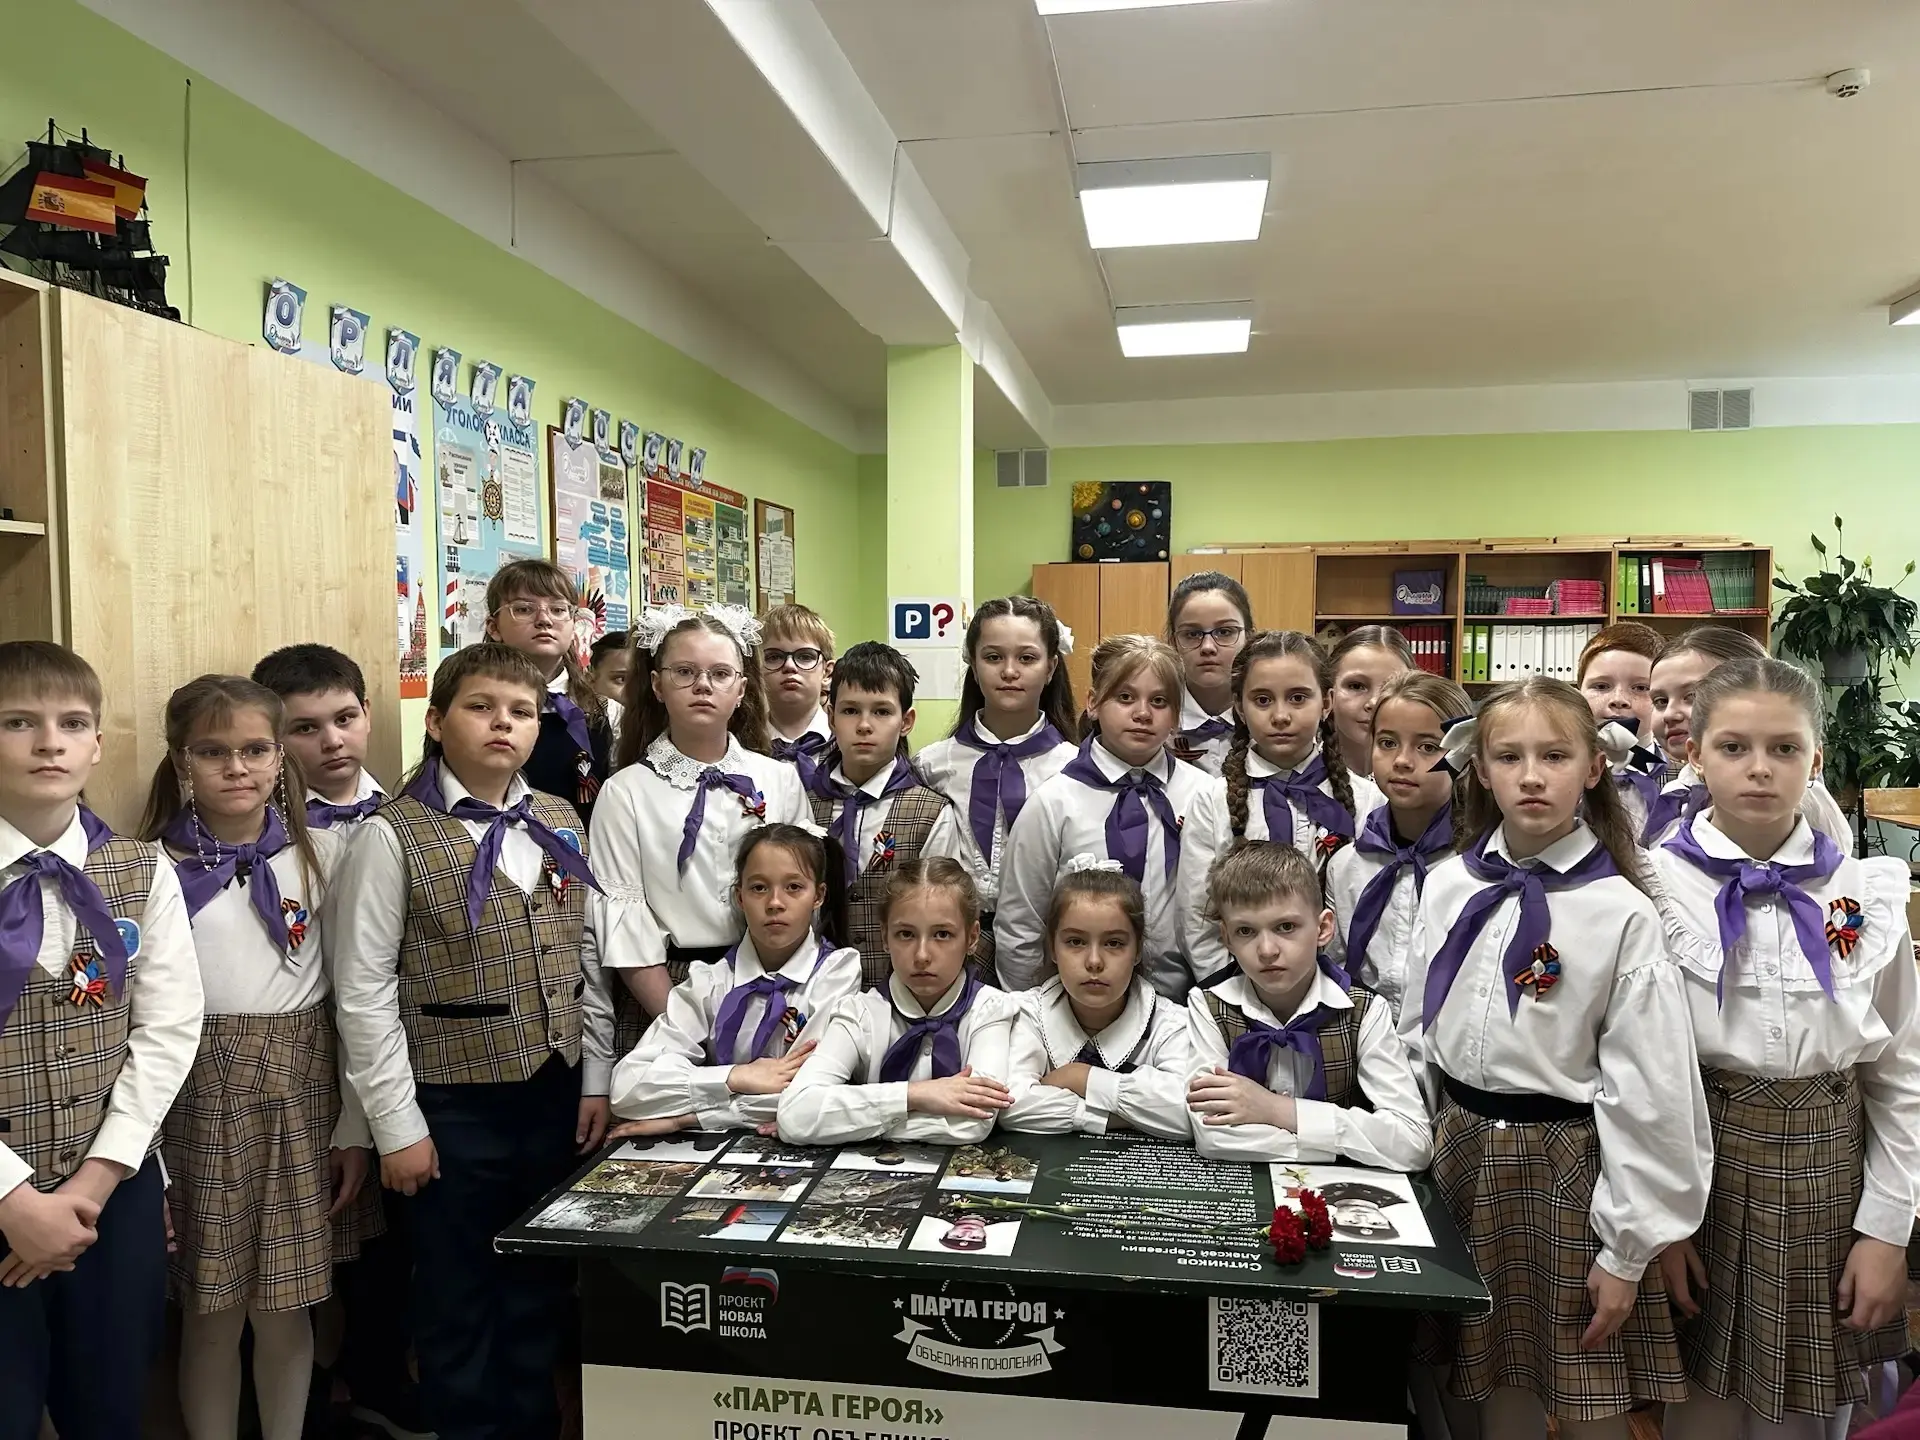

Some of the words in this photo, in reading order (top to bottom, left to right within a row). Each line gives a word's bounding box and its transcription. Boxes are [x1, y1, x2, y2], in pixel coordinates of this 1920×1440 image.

[1121, 1245, 1196, 1257] Сергеевич
[1201, 1251, 1261, 1261] Алексей
[1177, 1258, 1262, 1271] Ситников
[718, 1294, 766, 1308] ПРОЕКТ
[910, 1293, 978, 1318] ПАРТА
[982, 1300, 1047, 1324] ГЕРОЯ
[719, 1310, 763, 1323] НОВАЯ
[719, 1325, 767, 1339] ШКОЛА
[981, 1352, 1043, 1371] ПОКОЛЕНИЯ
[713, 1386, 824, 1417] «ПАРТА
[832, 1393, 944, 1425] ГЕРОЯ»
[714, 1420, 802, 1440] ПРОЕКТ
